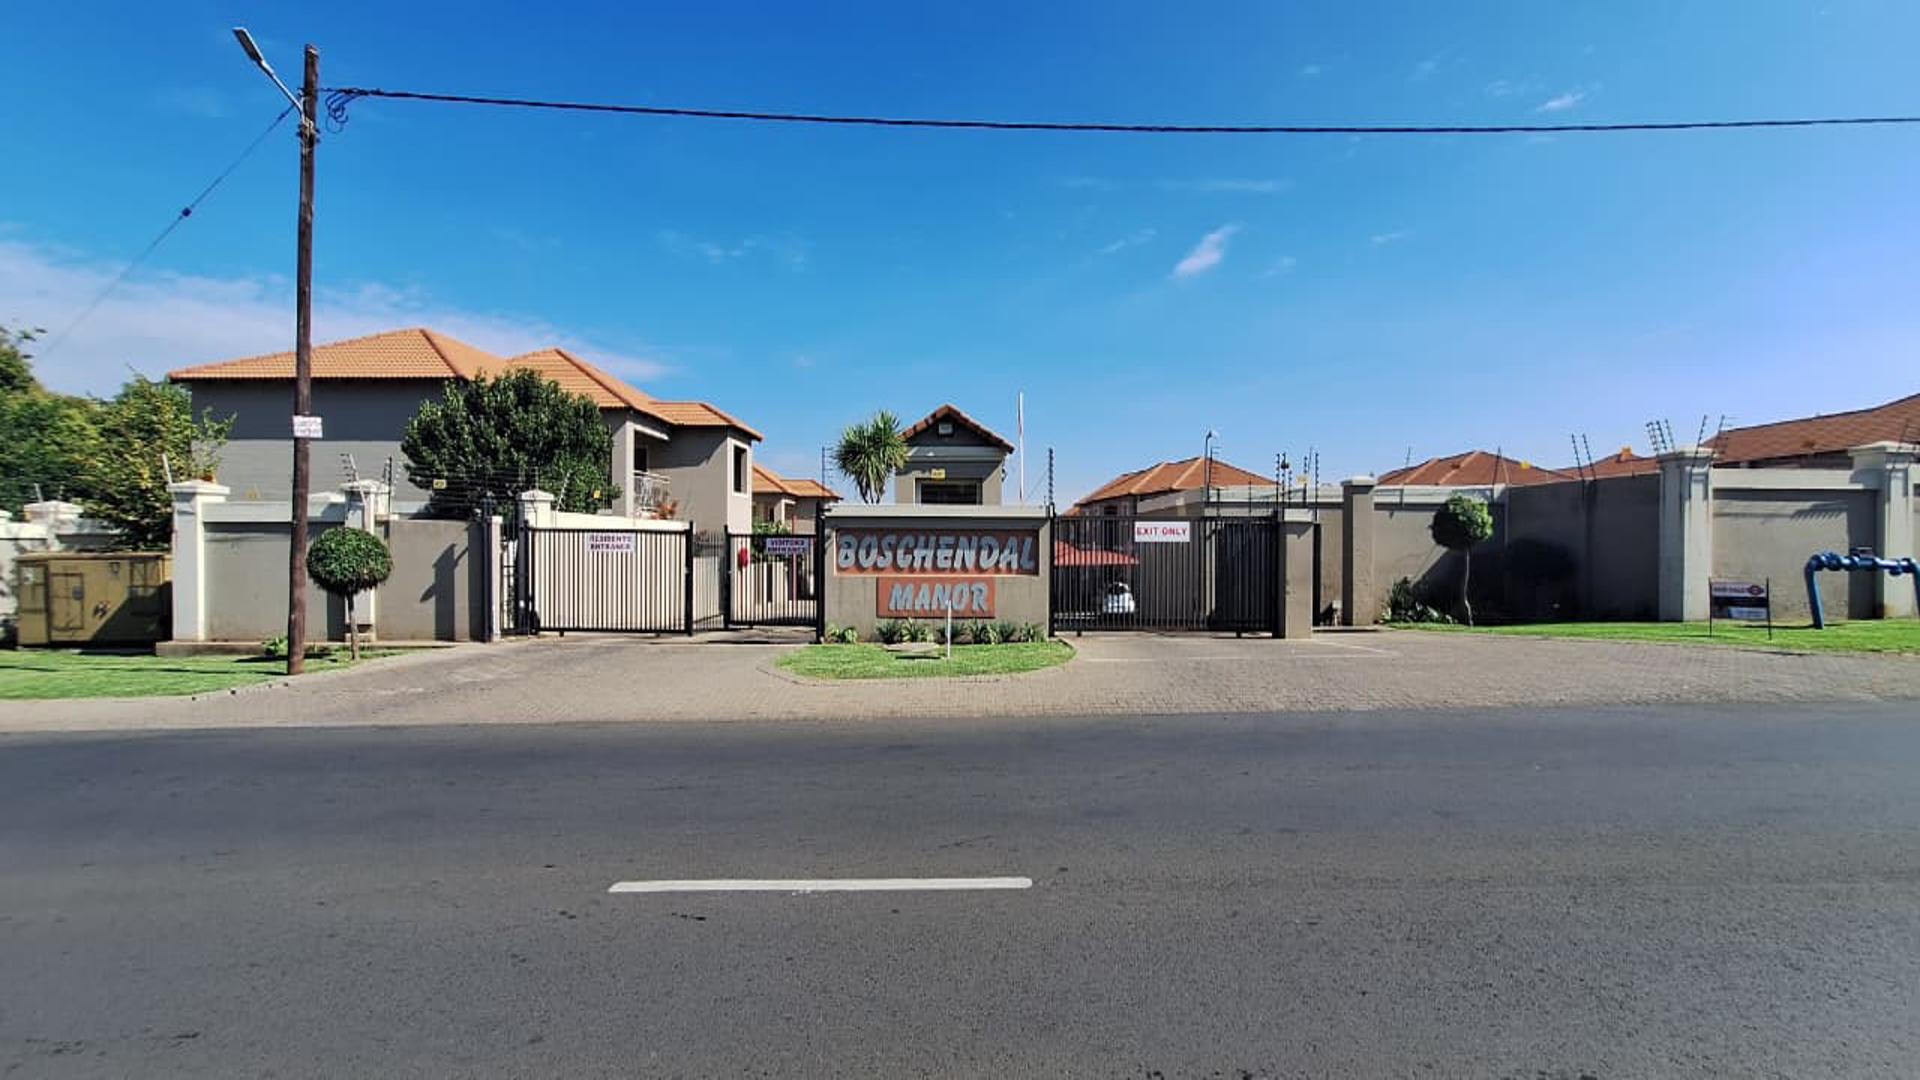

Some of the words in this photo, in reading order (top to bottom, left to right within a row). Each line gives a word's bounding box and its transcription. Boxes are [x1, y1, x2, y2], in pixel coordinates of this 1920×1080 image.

[1136, 527, 1157, 536] EXIT
[1162, 526, 1187, 536] ONLY
[838, 534, 1035, 570] BOSCHENDAL
[889, 582, 989, 613] MANOR
